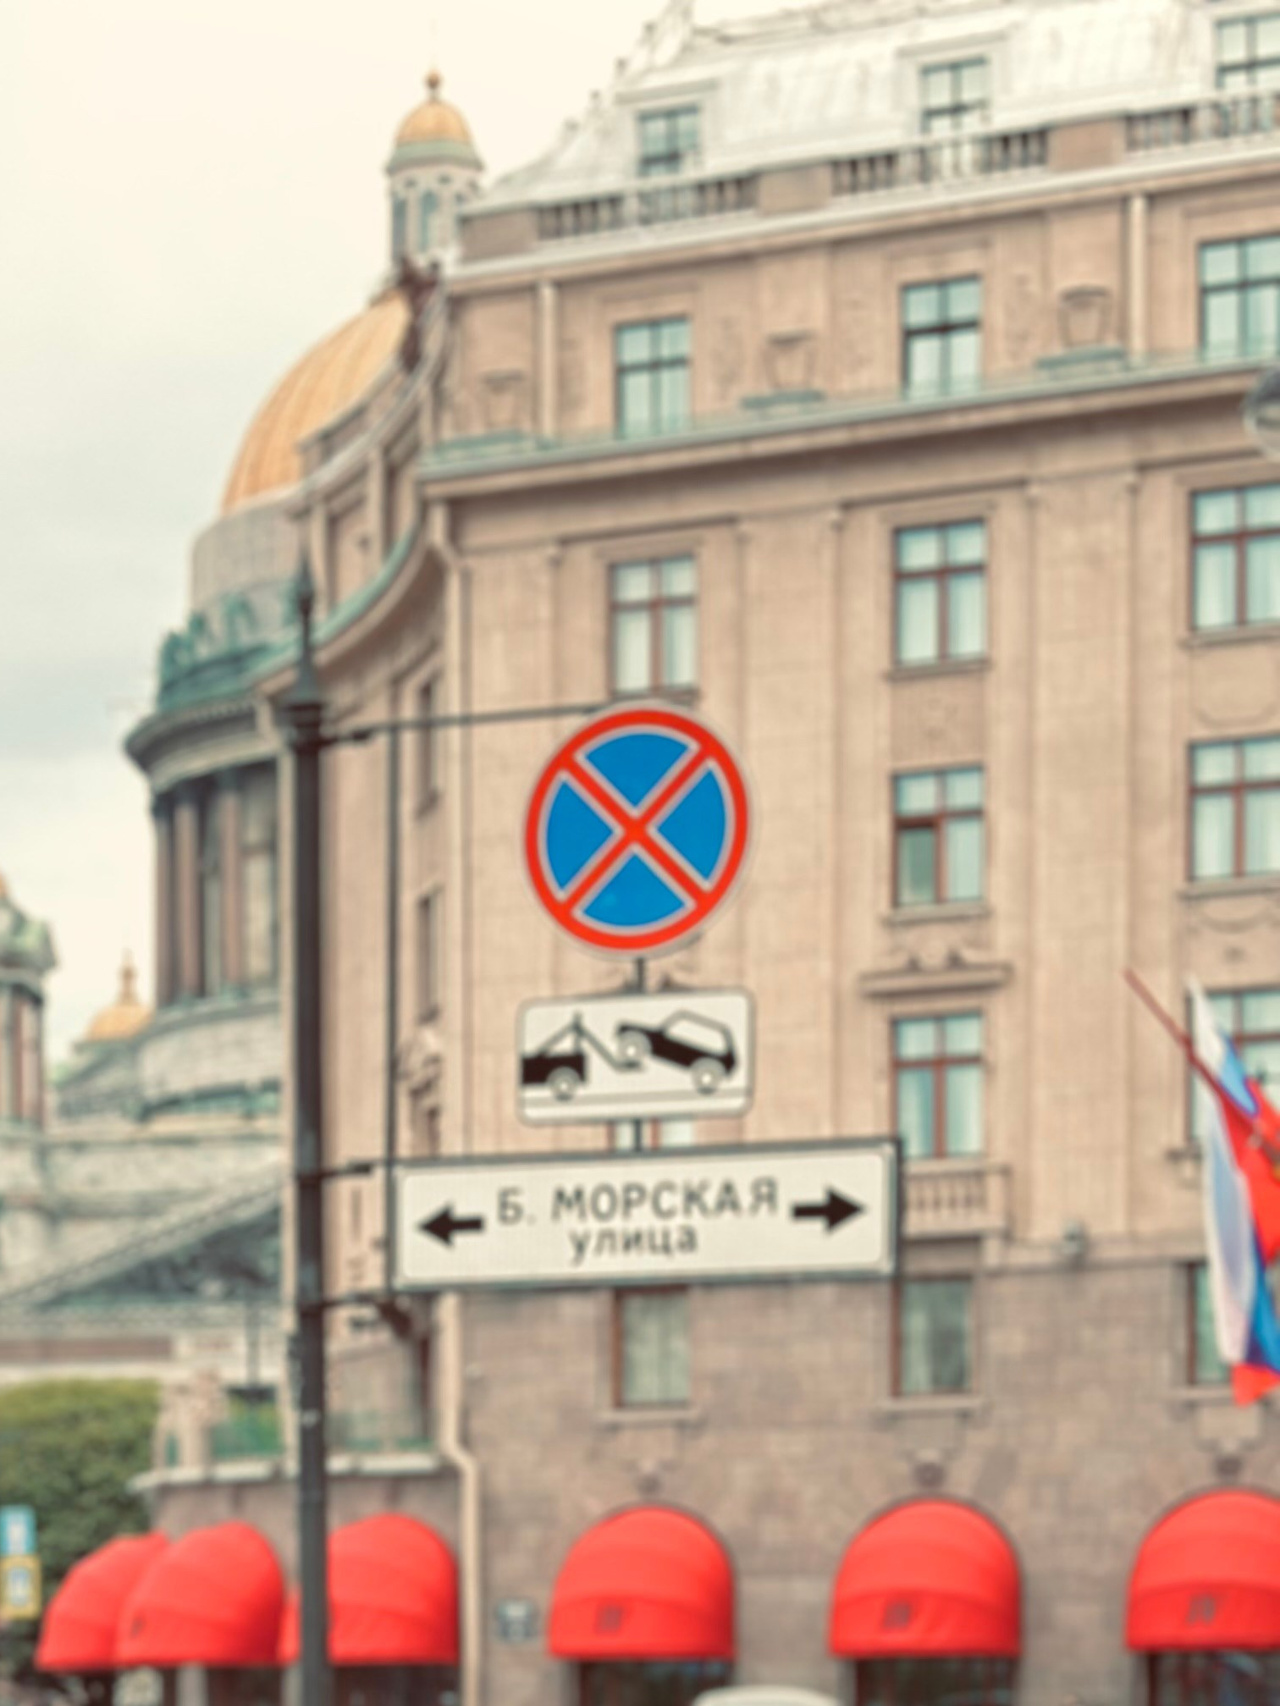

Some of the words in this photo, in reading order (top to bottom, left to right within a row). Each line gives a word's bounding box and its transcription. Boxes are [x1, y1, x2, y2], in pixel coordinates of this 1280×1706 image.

[496, 1187, 536, 1224] Б.
[551, 1177, 779, 1221] МОРСКАЯ
[569, 1225, 697, 1265] улица
